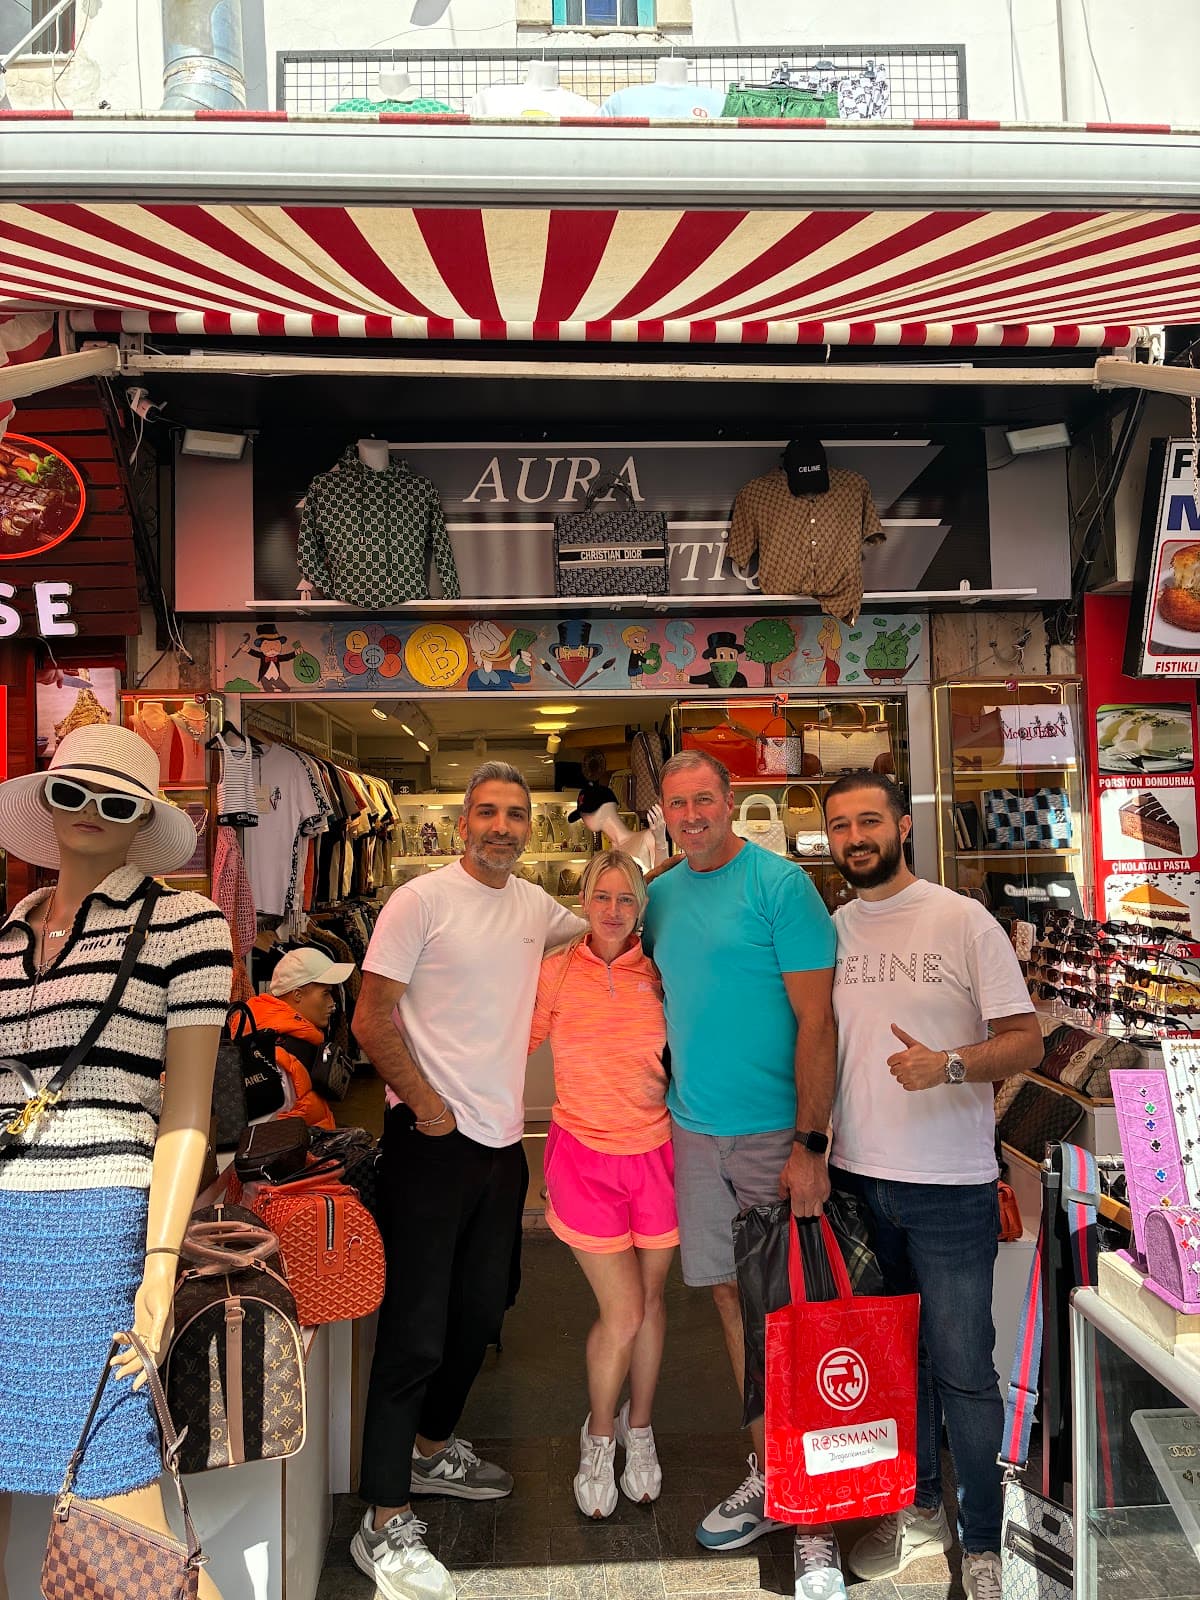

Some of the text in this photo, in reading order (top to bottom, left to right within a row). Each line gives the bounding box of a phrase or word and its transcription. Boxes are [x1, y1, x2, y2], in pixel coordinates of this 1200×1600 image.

[798, 464, 821, 473] CELINE
[462, 456, 645, 503] AURA
[580, 550, 642, 560] CHRISTIAN DIOR
[1155, 661, 1198, 672] FISTIKLI
[1099, 776, 1195, 788] PORSİYON DONDURMA
[1112, 860, 1190, 874] ÇİKOLATALI PASTA
[812, 1427, 888, 1452] ROSSMANN
